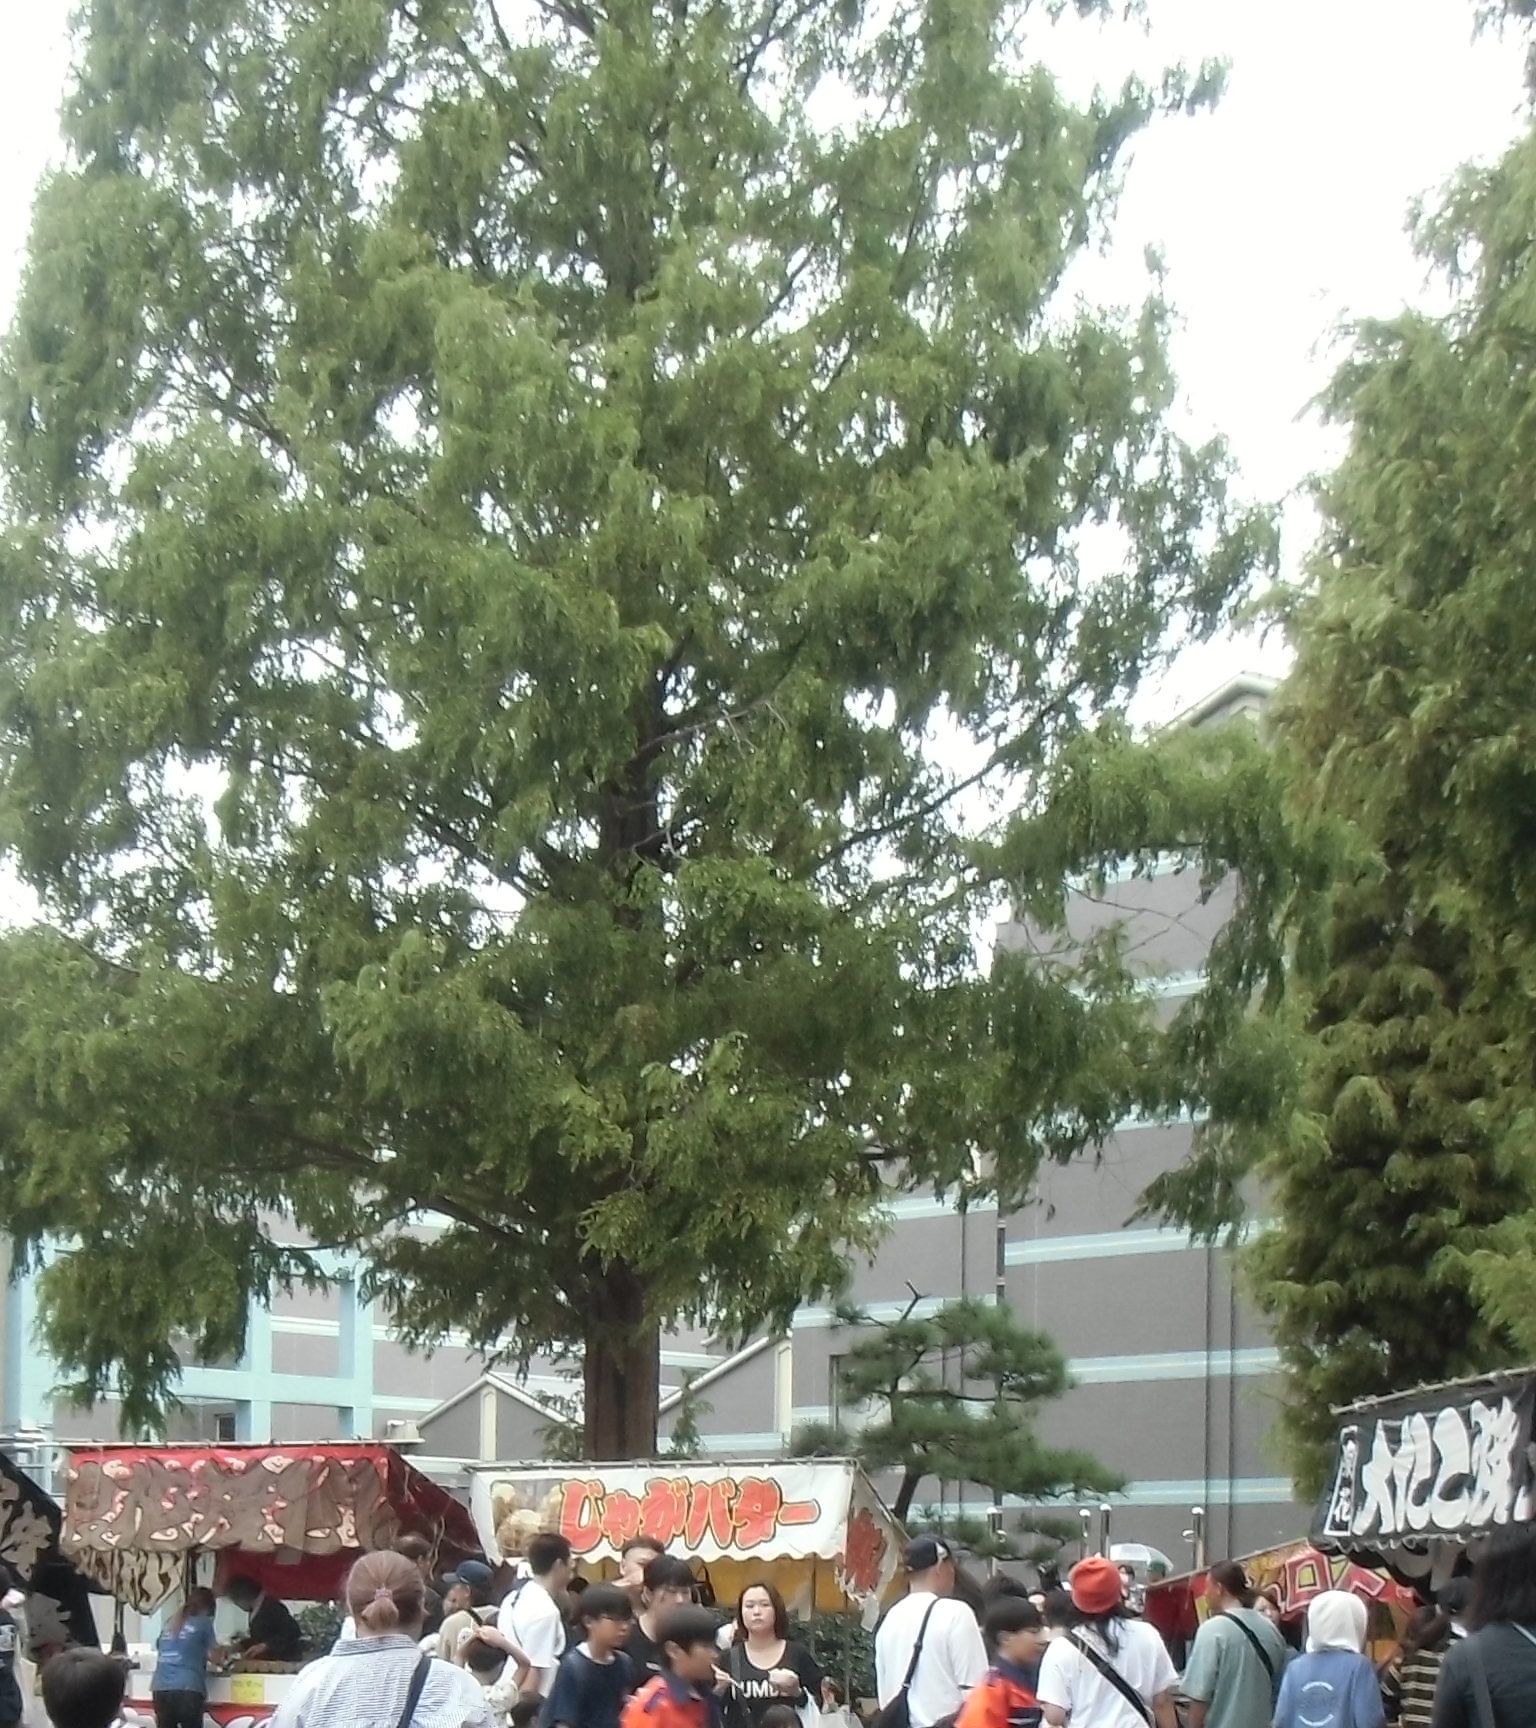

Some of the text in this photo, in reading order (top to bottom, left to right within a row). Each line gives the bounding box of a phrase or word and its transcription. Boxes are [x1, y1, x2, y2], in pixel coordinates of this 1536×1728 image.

[560, 1476, 821, 1553] じゃがバター
